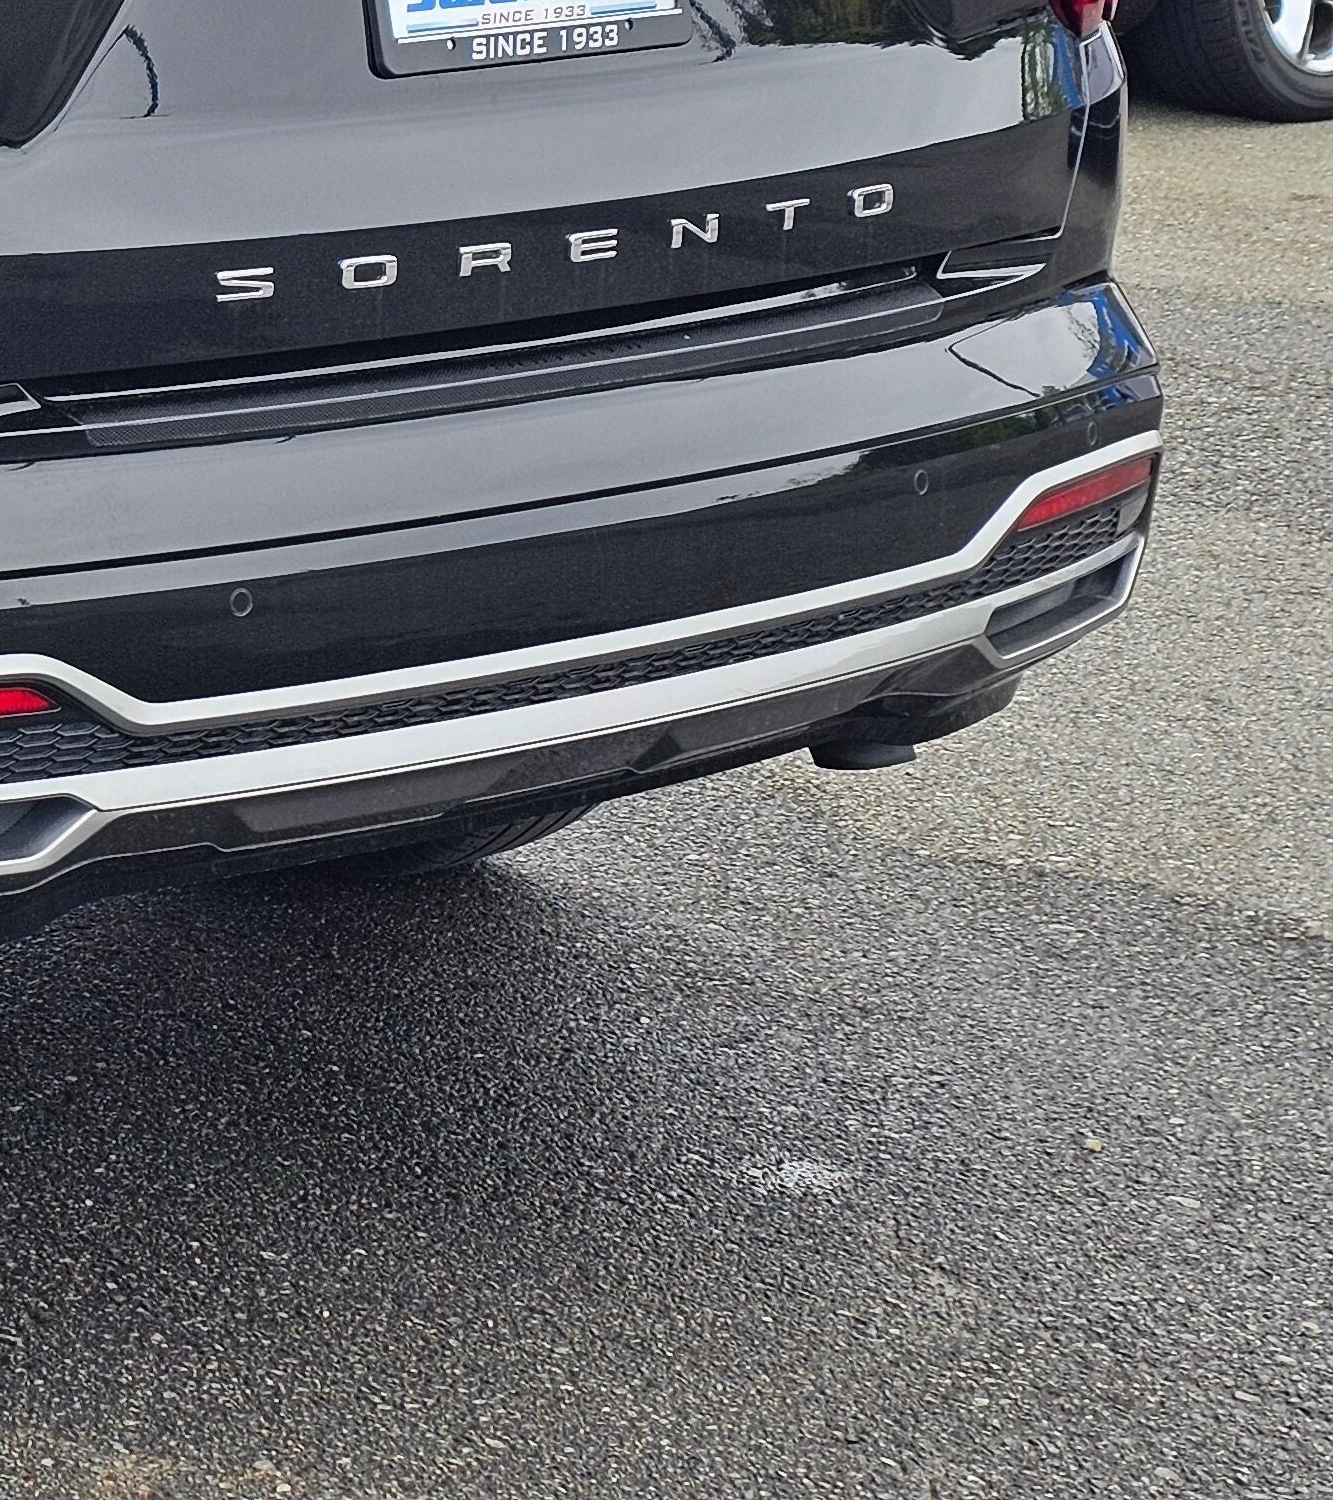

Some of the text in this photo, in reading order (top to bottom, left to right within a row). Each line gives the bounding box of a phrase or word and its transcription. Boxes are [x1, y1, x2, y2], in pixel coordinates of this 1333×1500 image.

[481, 4, 586, 25] SINCE 1933
[471, 24, 619, 60] SINCE 1933
[215, 183, 894, 303] SORENTO
